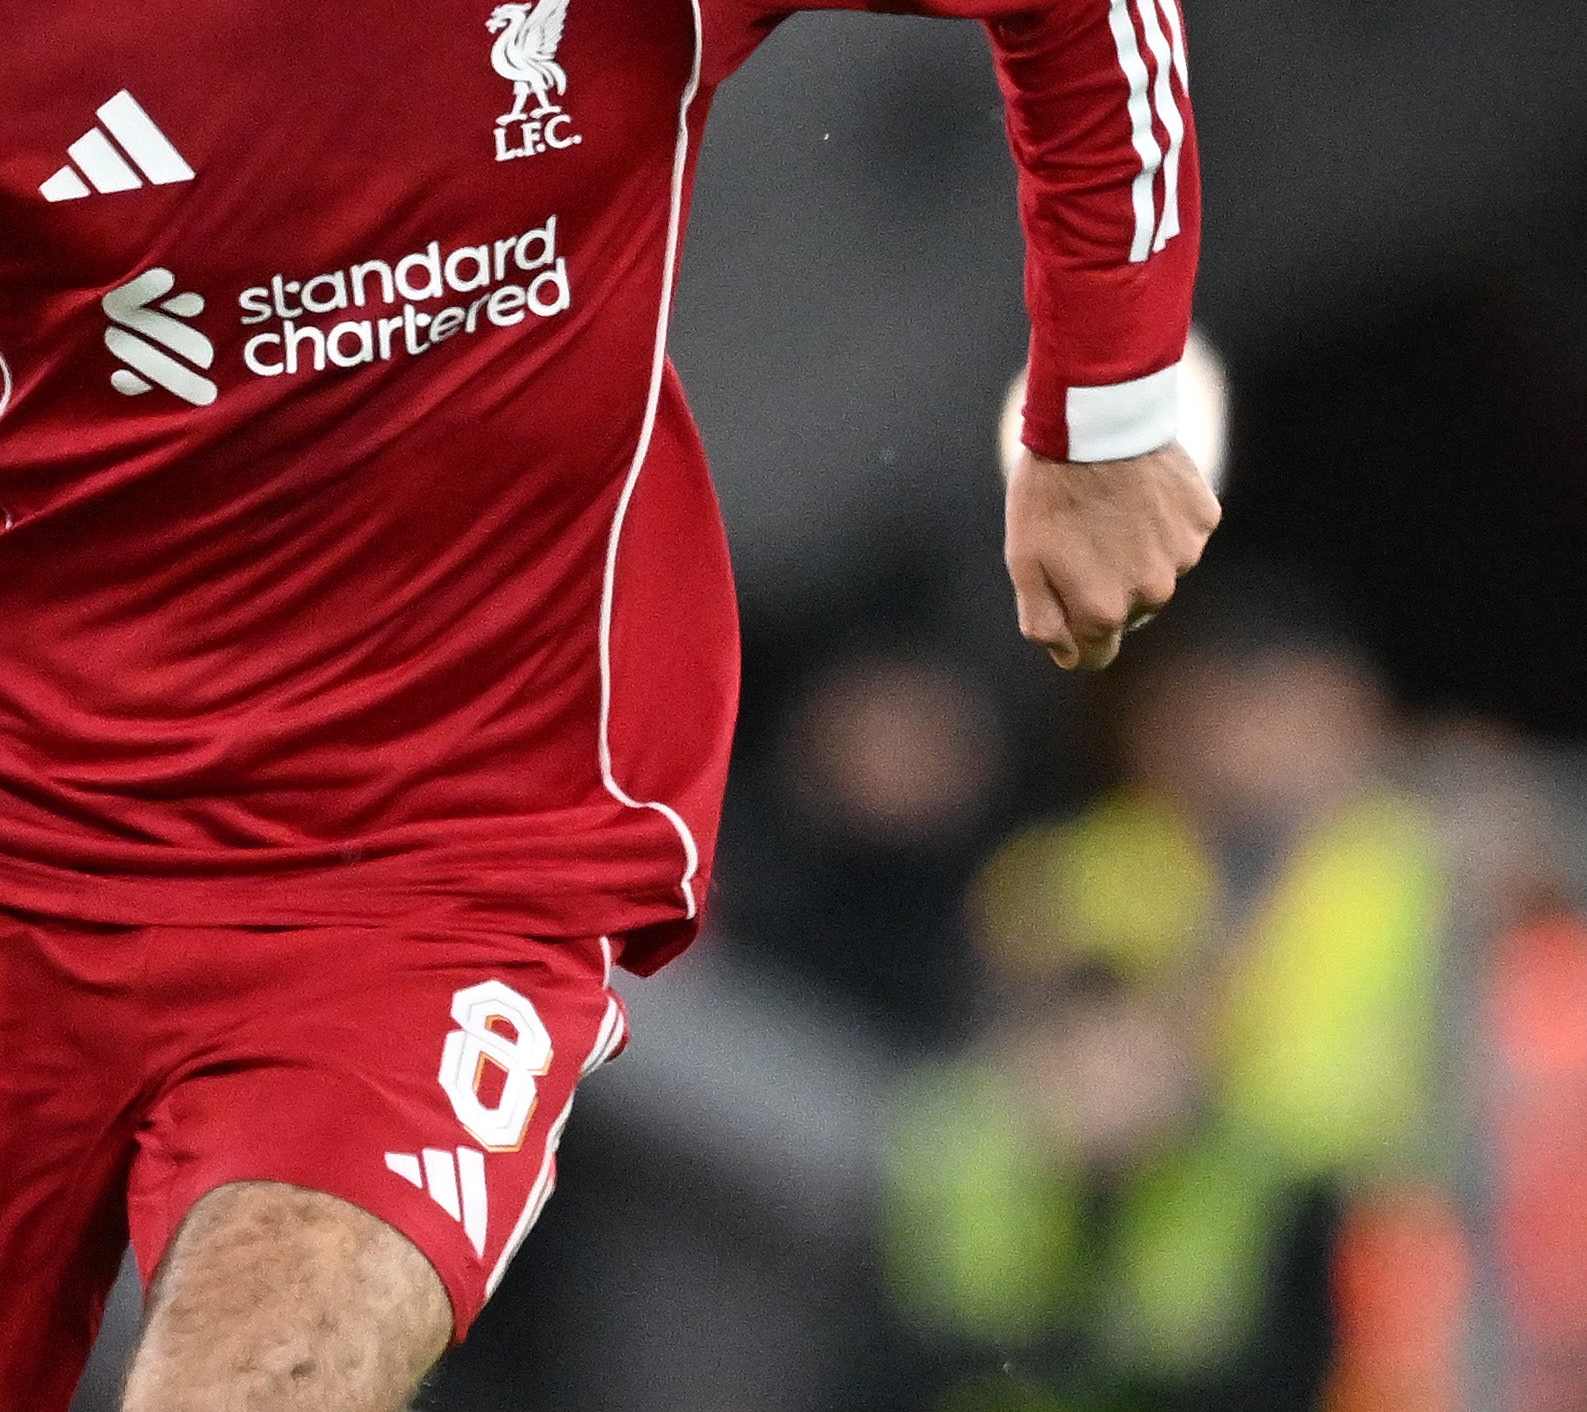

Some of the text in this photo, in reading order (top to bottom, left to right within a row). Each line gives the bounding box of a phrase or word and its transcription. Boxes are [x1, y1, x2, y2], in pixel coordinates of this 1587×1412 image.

[237, 214, 557, 325] standard
[243, 256, 571, 377] chartered
[437, 979, 554, 1153] 8
